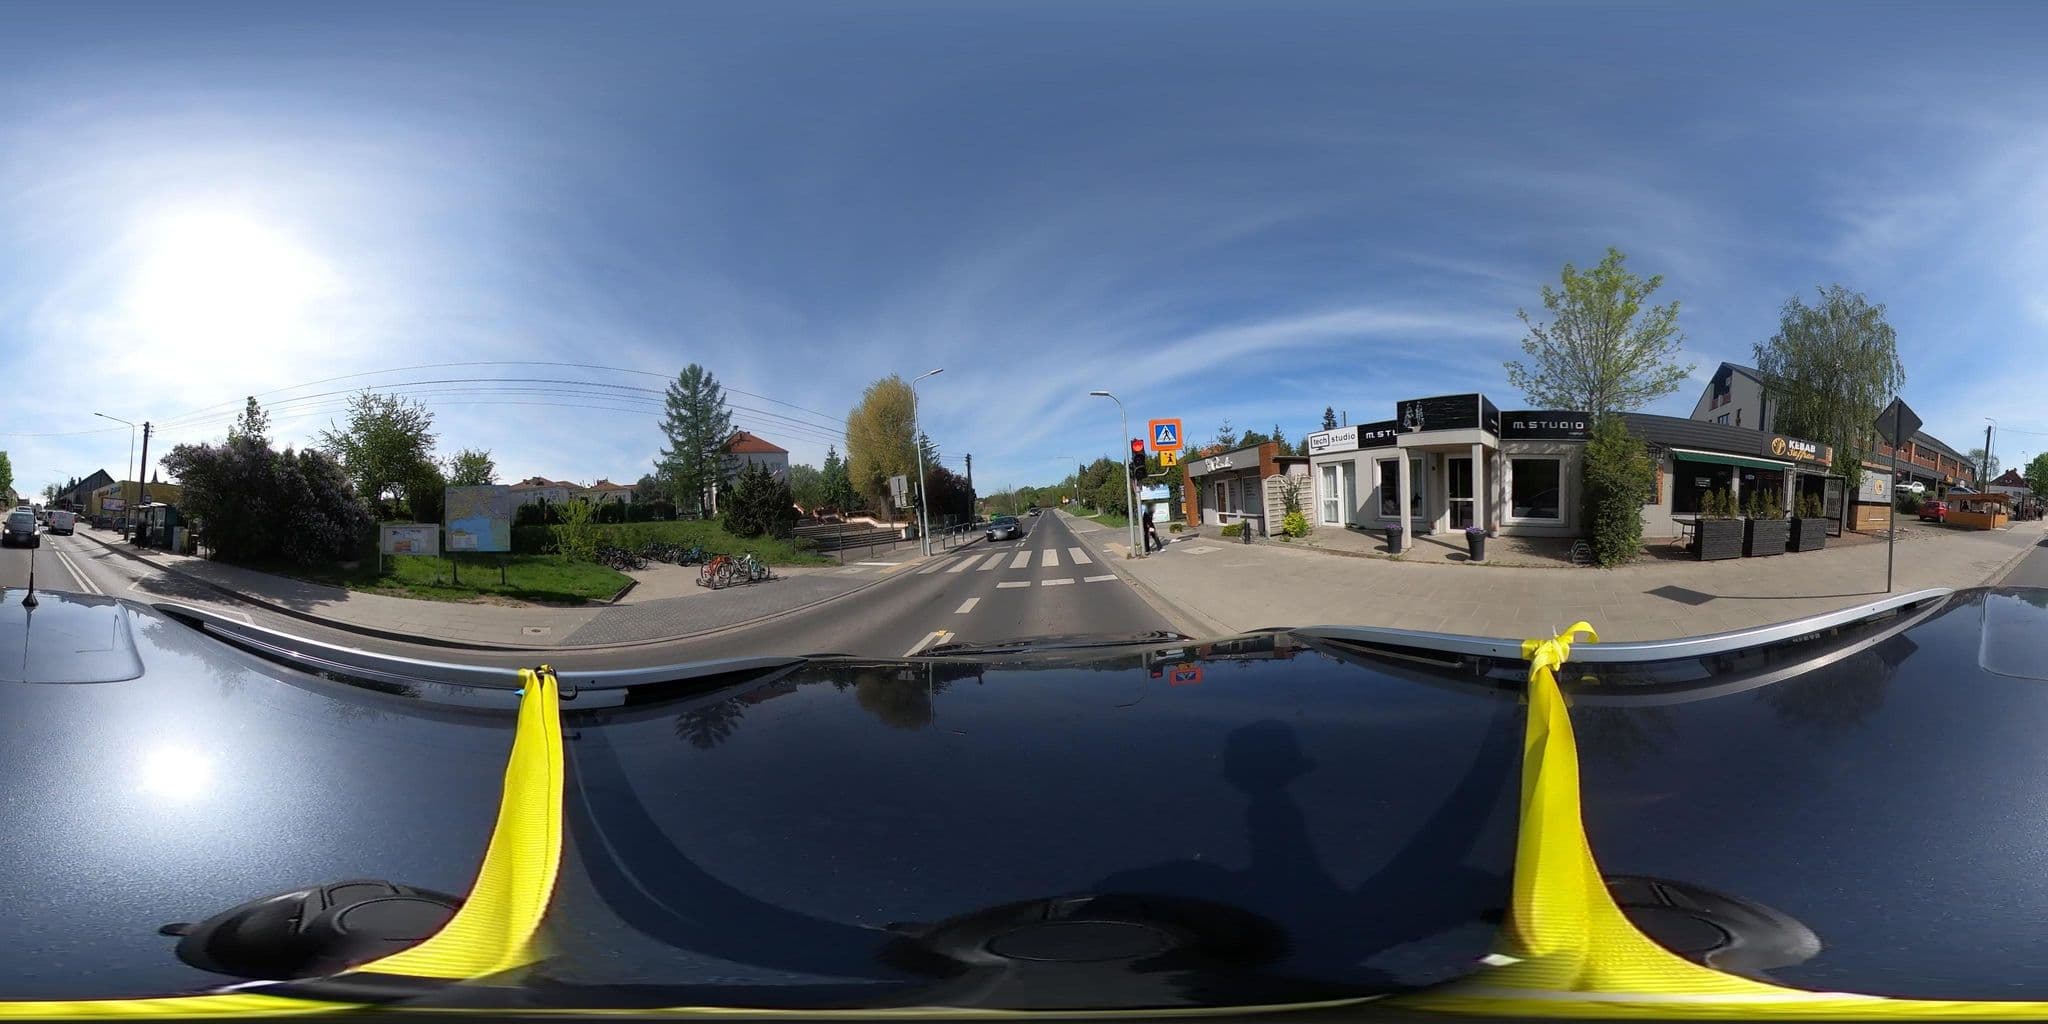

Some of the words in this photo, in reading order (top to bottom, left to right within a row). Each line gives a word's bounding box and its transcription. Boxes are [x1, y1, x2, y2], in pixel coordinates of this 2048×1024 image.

[1528, 421, 1584, 429] STUDIO
[1313, 438, 1328, 446] tech
[1331, 433, 1355, 442] studio
[1788, 440, 1816, 453] KEBAB
